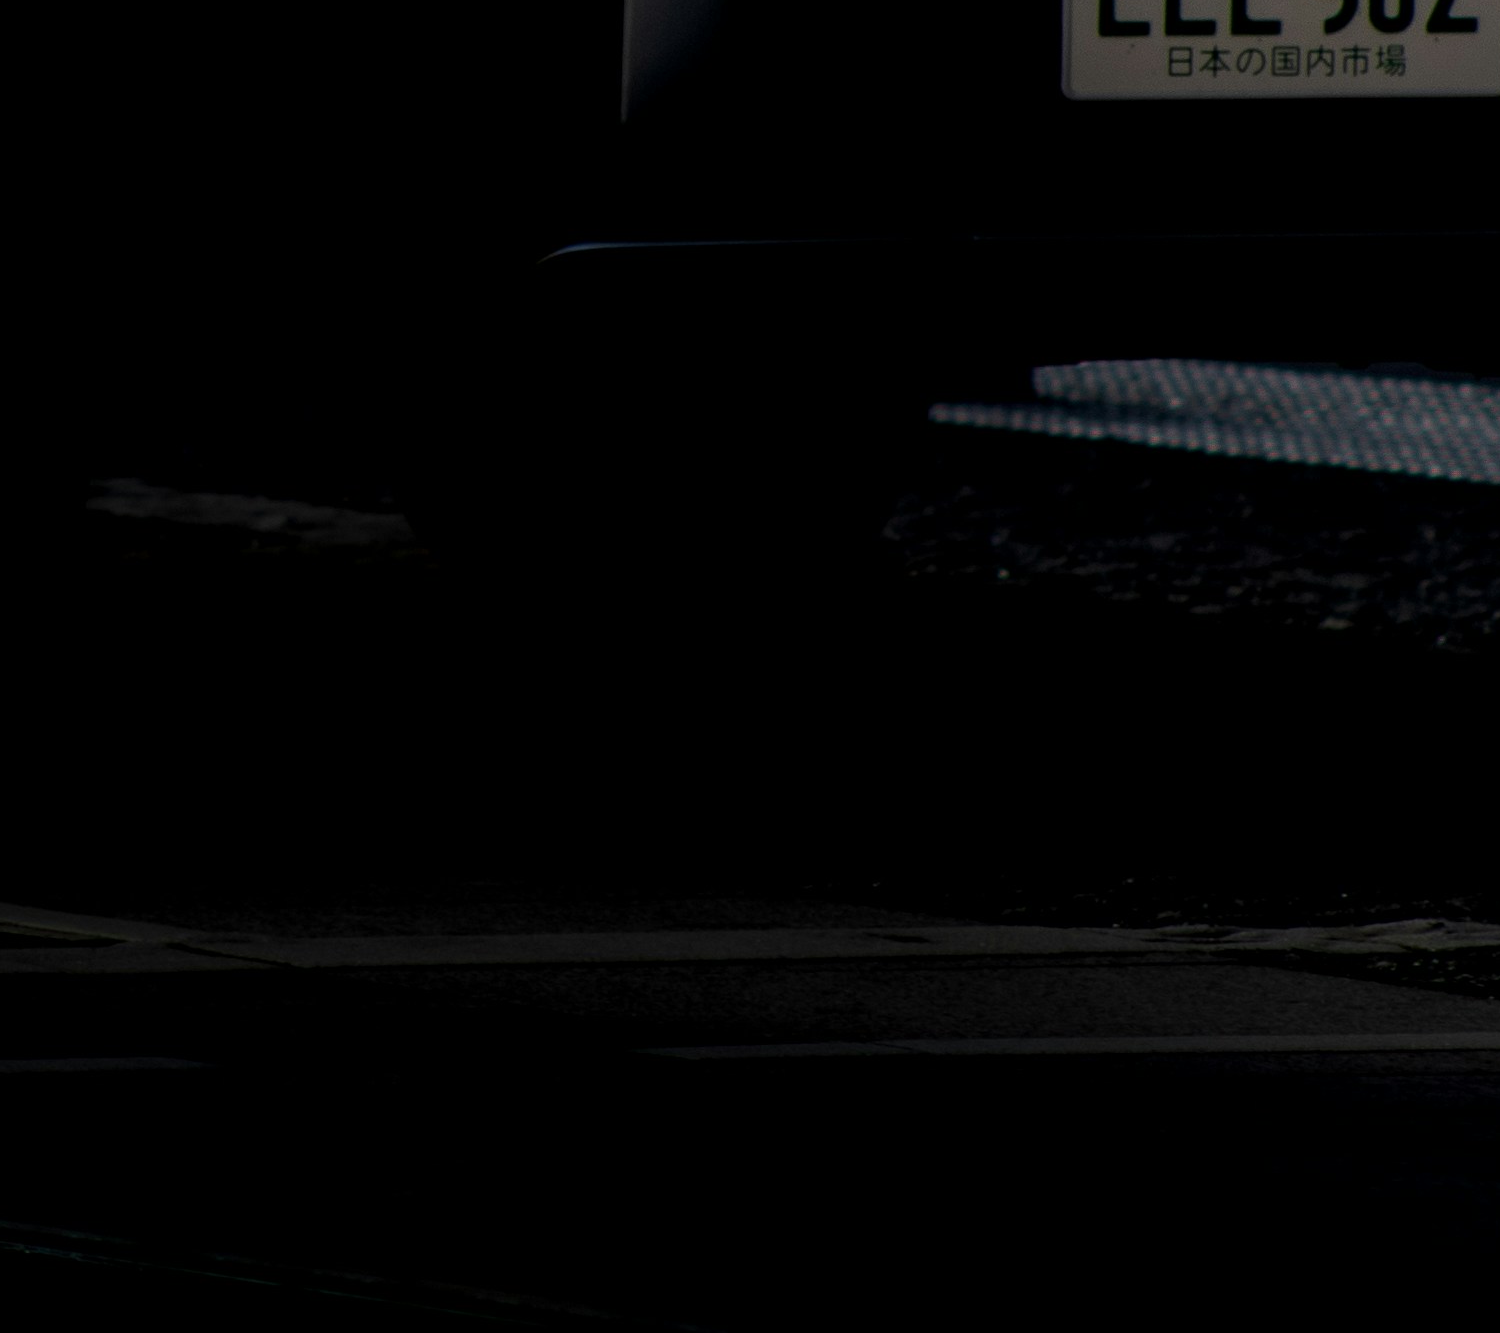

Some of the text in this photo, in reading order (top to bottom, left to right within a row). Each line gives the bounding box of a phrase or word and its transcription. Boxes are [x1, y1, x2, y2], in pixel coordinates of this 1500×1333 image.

[1167, 45, 1408, 78] 日本の国内市場
